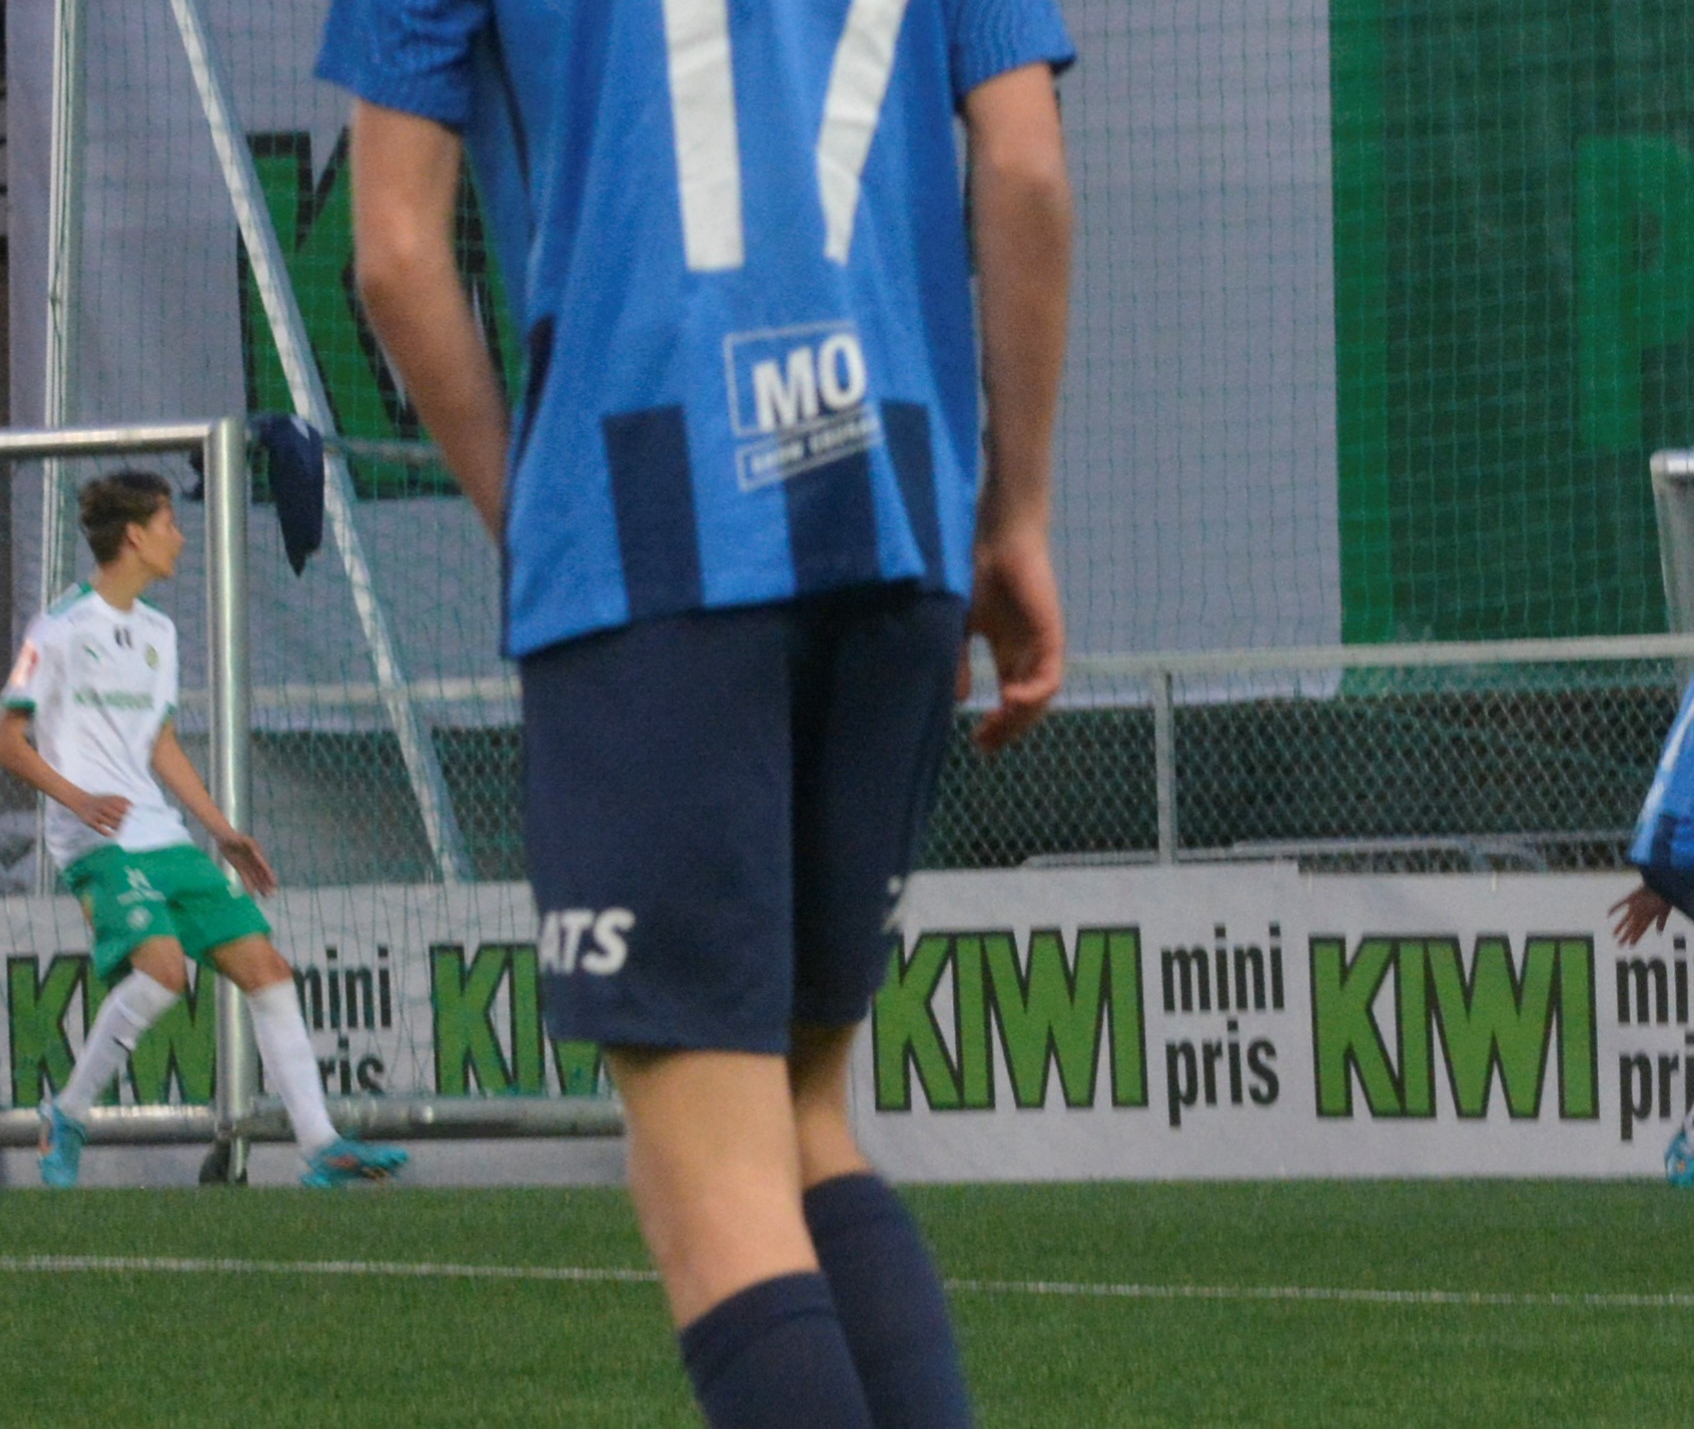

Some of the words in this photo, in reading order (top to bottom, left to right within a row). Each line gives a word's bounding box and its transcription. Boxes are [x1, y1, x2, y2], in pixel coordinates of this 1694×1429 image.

[538, 907, 636, 975] ATS
[871, 925, 1149, 1111] KIWI
[1160, 921, 1285, 1012] mini
[1165, 1017, 1281, 1128] pris
[1308, 934, 1600, 1119] KIWI
